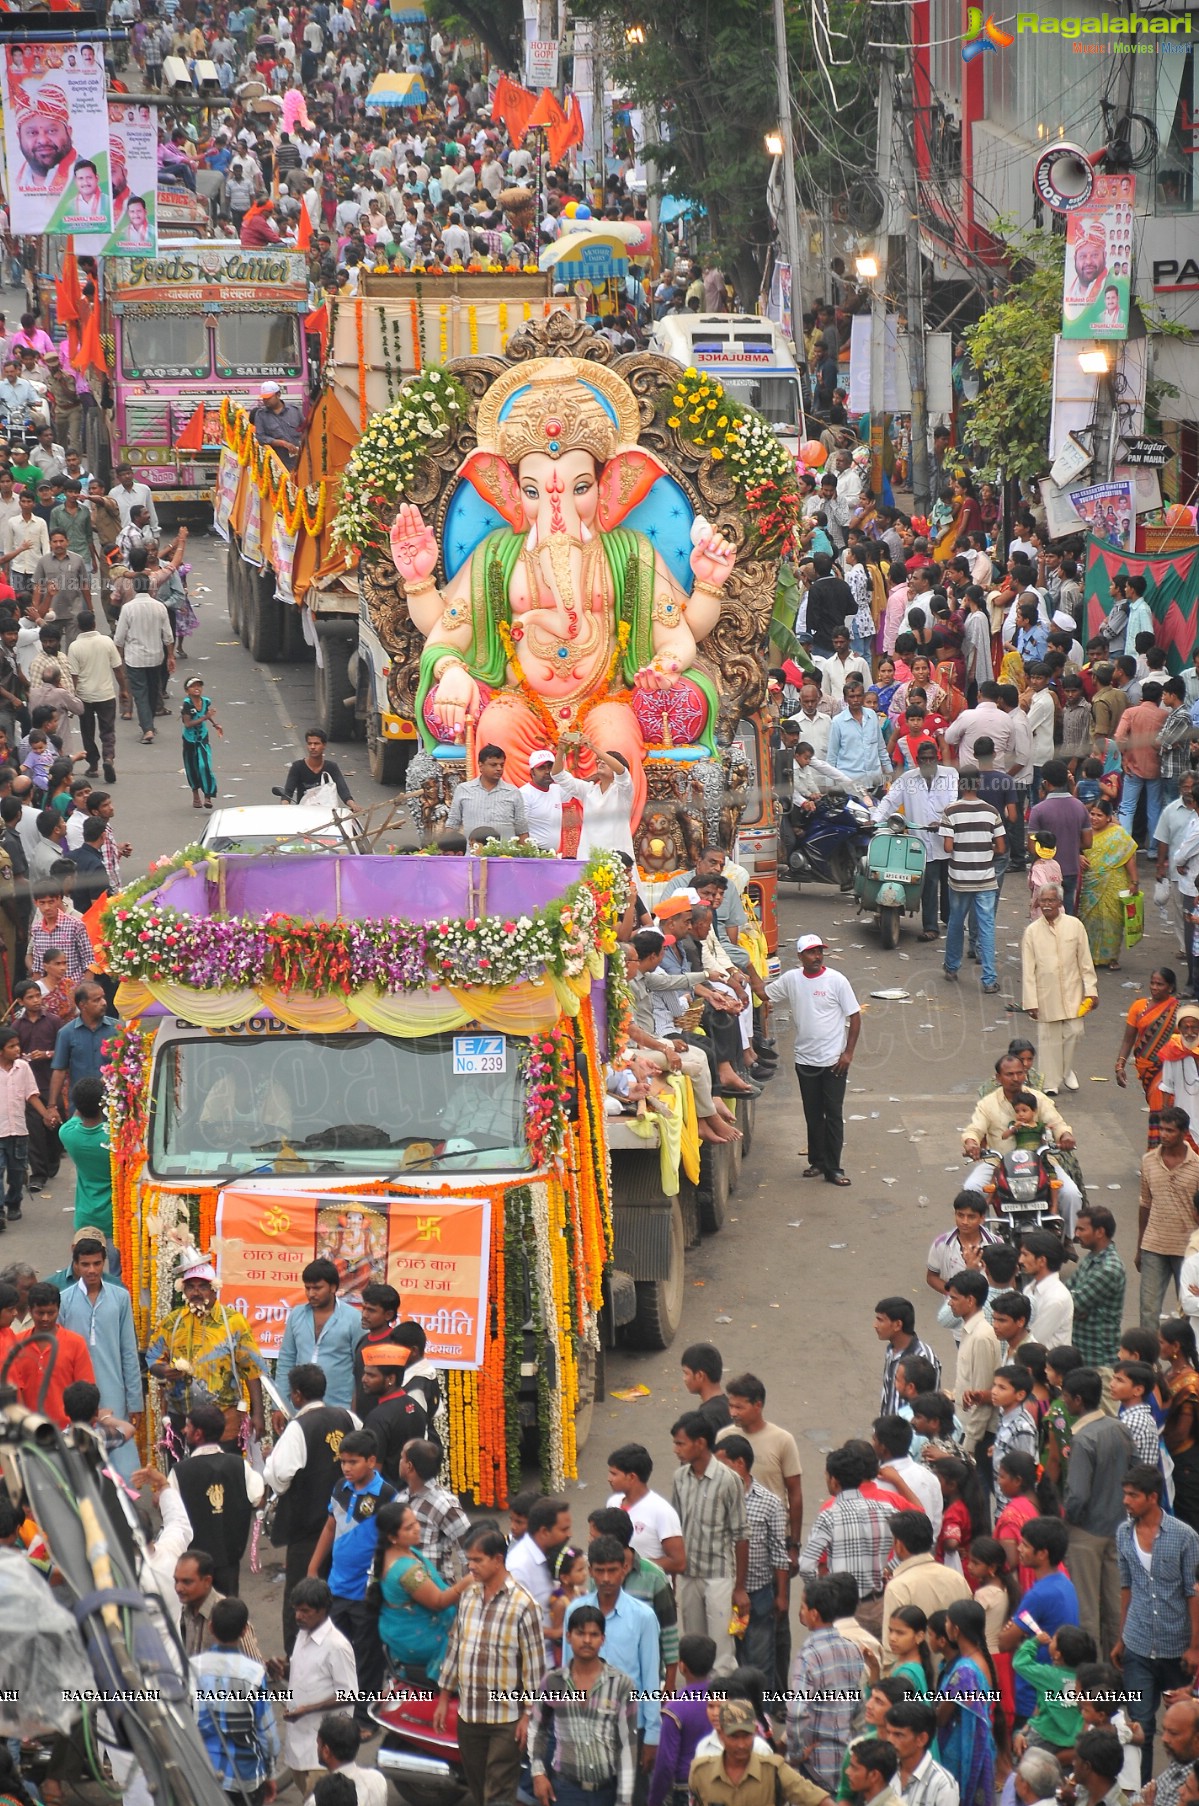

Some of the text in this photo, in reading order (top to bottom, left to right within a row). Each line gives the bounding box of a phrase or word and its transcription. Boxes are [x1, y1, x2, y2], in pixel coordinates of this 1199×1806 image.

[531, 42, 557, 50] HOTEL
[1037, 162, 1062, 207] SOUND
[130, 255, 293, 285] Goods Carrier
[142, 367, 286, 377] AQSA SALEHA
[1130, 441, 1168, 454] Muqtar
[1127, 455, 1166, 464] PAN MAHAL
[457, 1038, 503, 1055] E/Z
[457, 1056, 503, 1071] No. 239
[243, 1250, 304, 1264] लाल बाग
[396, 1257, 456, 1272] लाल बाग
[246, 1269, 299, 1283] का राजा
[400, 1279, 451, 1292] का राजा
